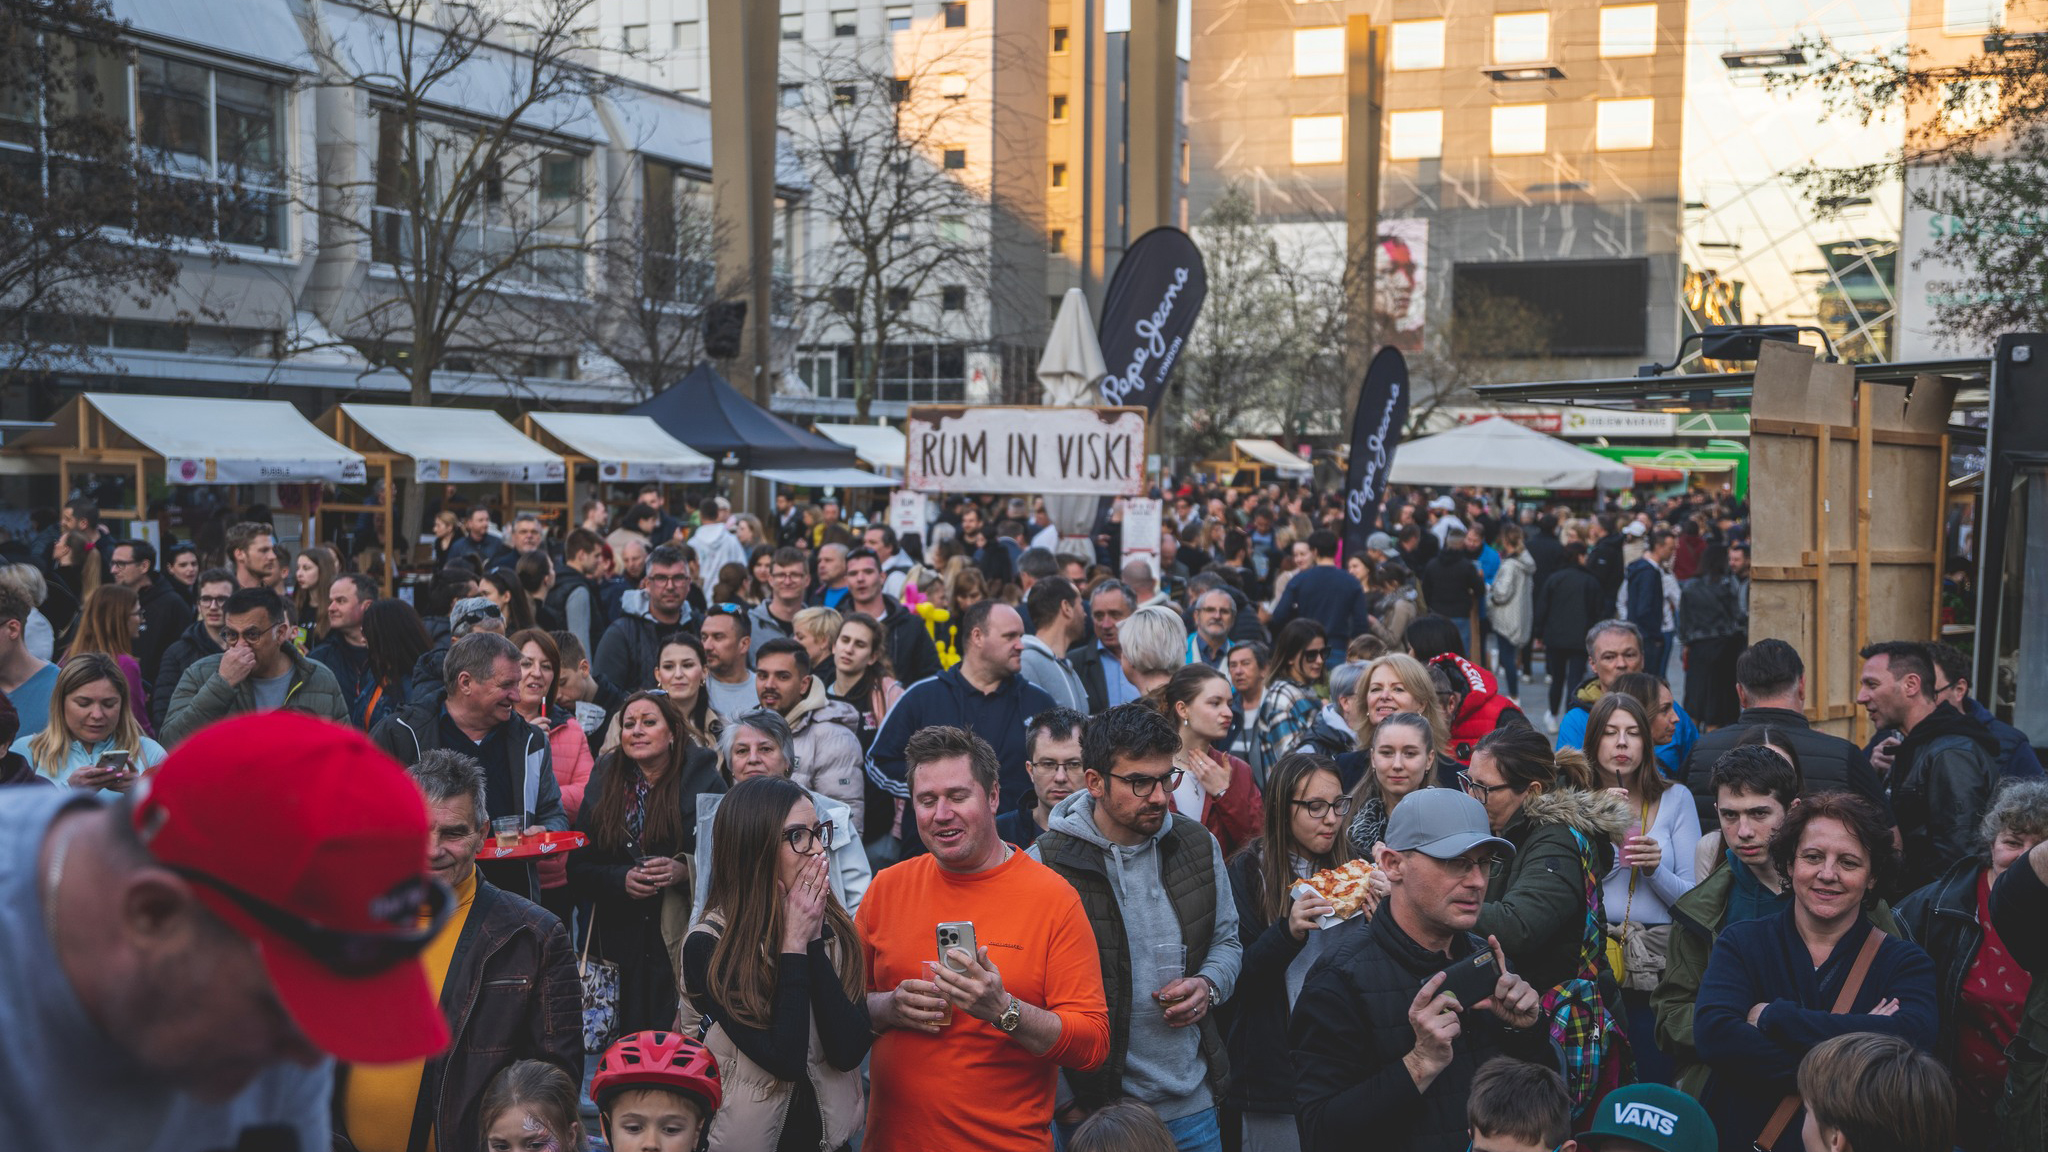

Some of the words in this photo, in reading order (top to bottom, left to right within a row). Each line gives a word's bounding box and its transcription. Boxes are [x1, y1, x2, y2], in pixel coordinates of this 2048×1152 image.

[1101, 346, 1149, 407] Pepe
[1135, 267, 1189, 360] Jeans
[1154, 335, 1184, 384] LONDON
[260, 466, 291, 477] BUBBLE
[921, 429, 988, 478] RUM
[1007, 432, 1037, 478] IN
[1057, 431, 1132, 480] VISKI
[1347, 460, 1376, 524] Pepe
[1367, 383, 1400, 470] Jeans
[1614, 1102, 1678, 1136] VANS
